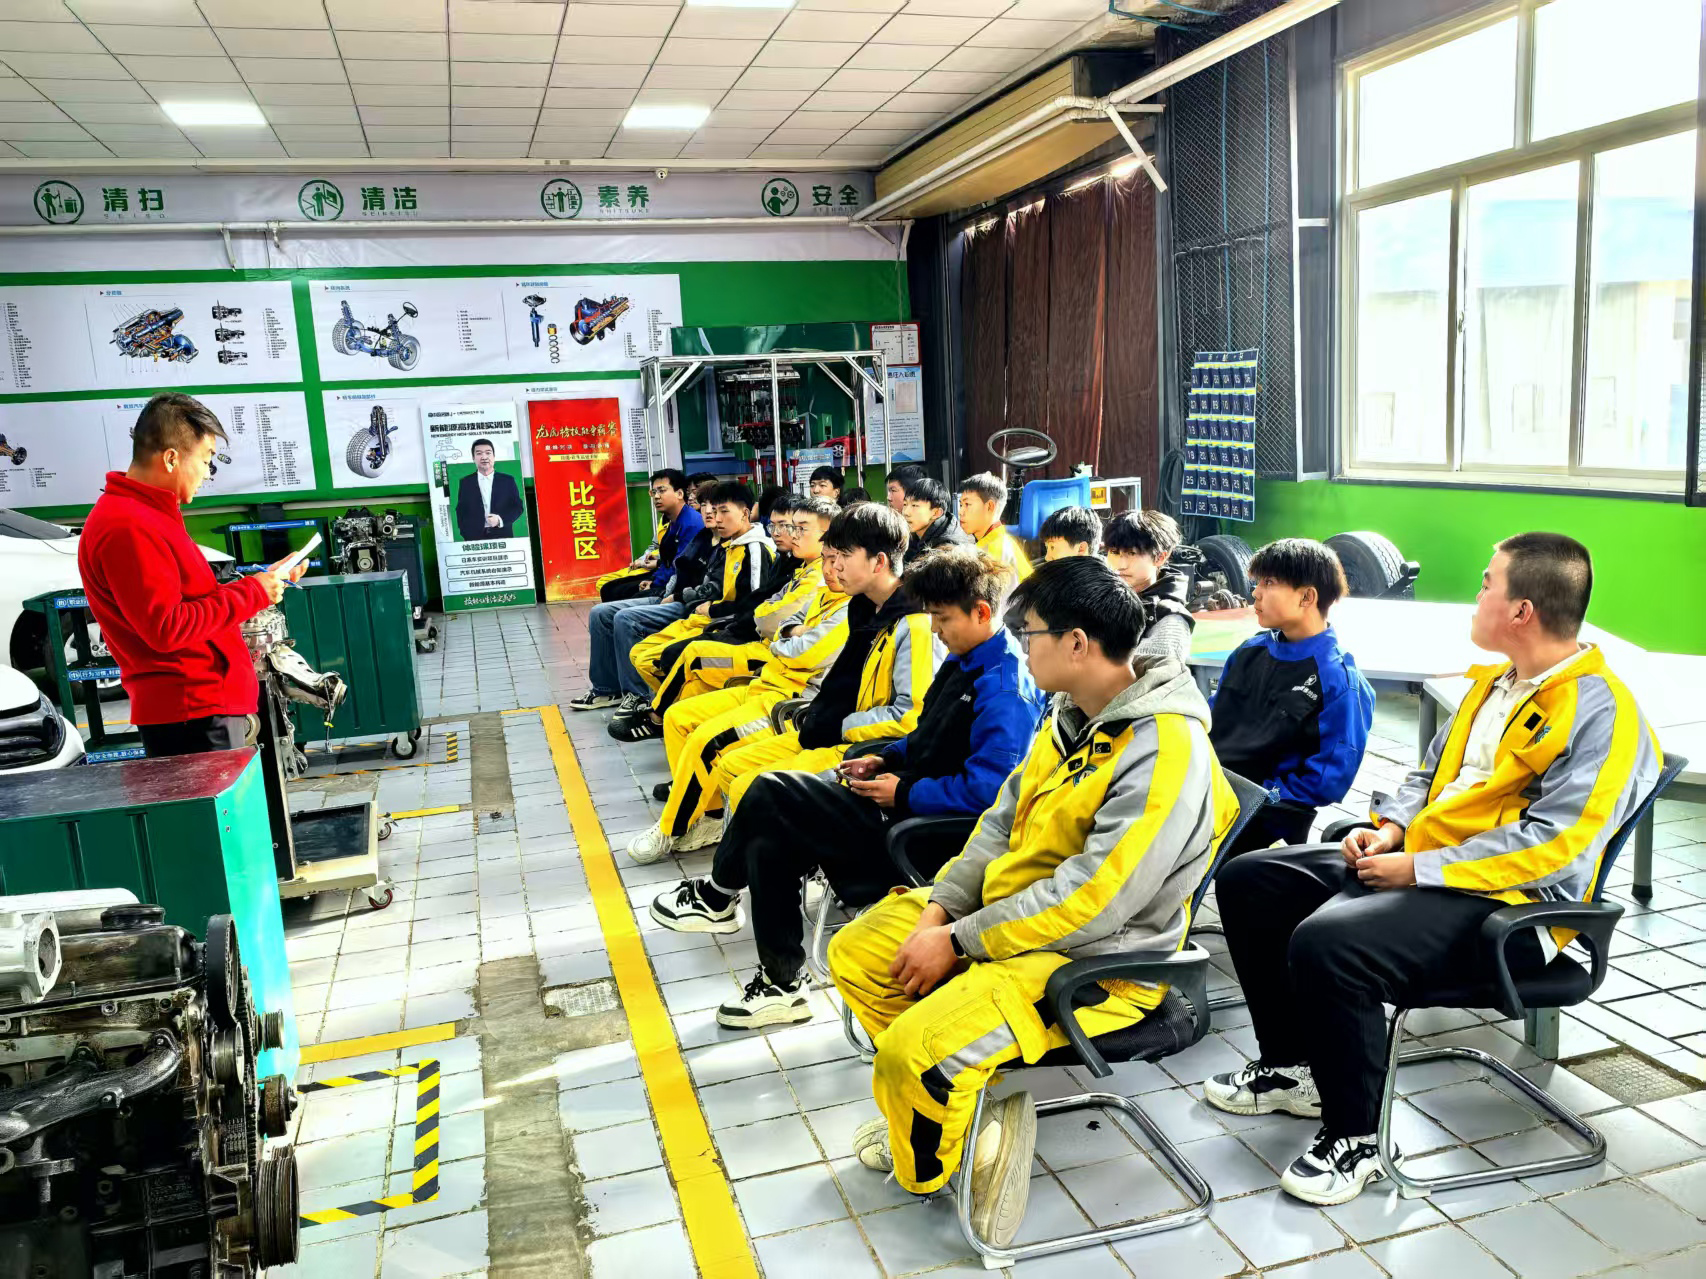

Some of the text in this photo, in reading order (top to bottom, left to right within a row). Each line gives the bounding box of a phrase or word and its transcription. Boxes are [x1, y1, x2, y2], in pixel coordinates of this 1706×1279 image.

[102, 187, 164, 212] 清扫
[360, 186, 418, 211] 清洁
[597, 185, 650, 208] 素养
[812, 184, 859, 207] 安全
[430, 420, 512, 433] 新能源高技能实训区
[568, 480, 600, 561] 比赛区
[462, 541, 507, 552] 体验课项目
